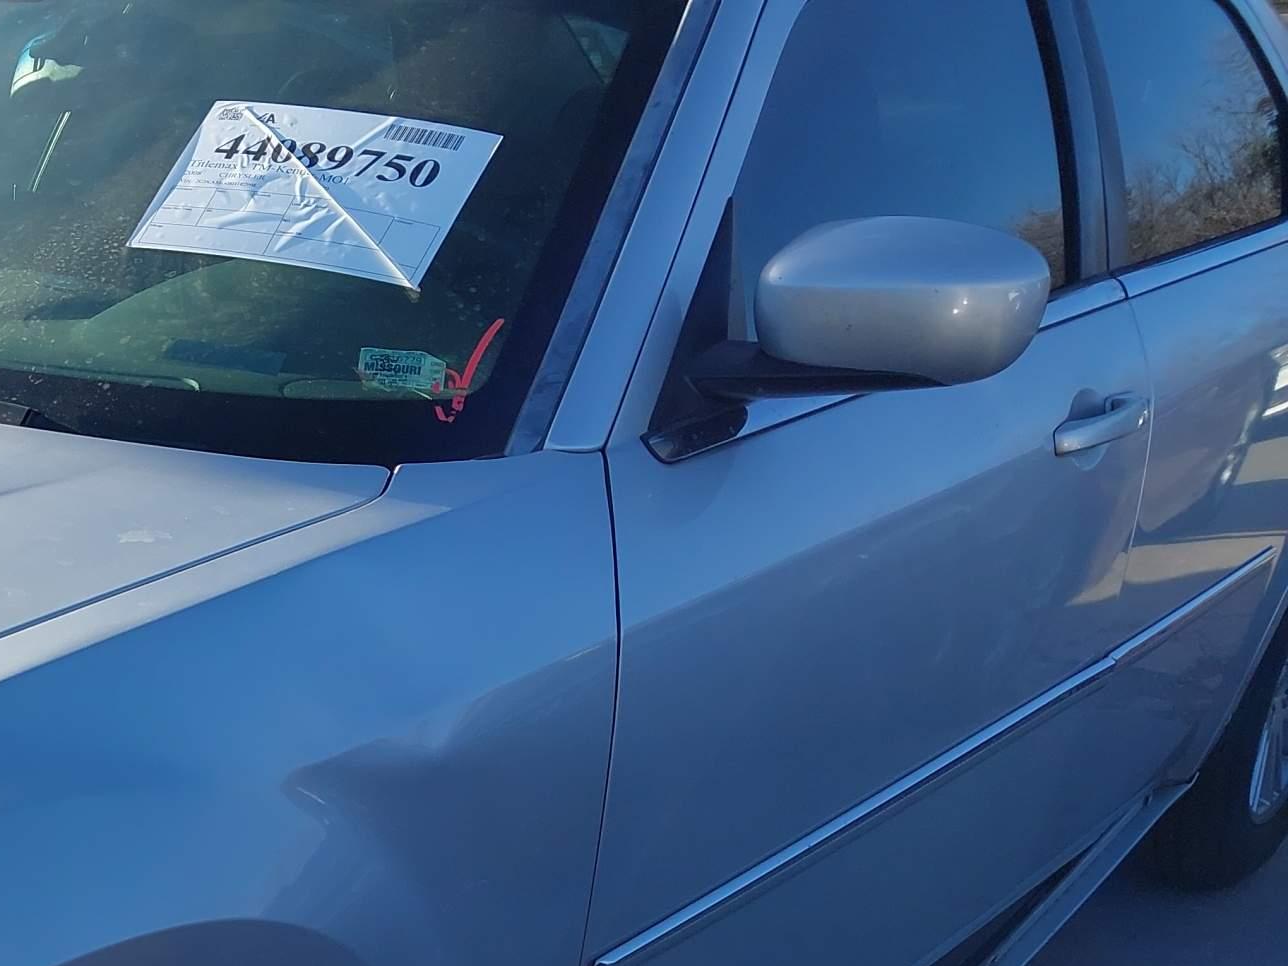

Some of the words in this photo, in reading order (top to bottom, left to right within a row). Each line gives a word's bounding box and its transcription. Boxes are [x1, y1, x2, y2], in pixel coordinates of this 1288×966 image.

[190, 159, 238, 171] Titlemax
[214, 132, 441, 188] 44089750
[363, 361, 422, 376] MISSOURI
